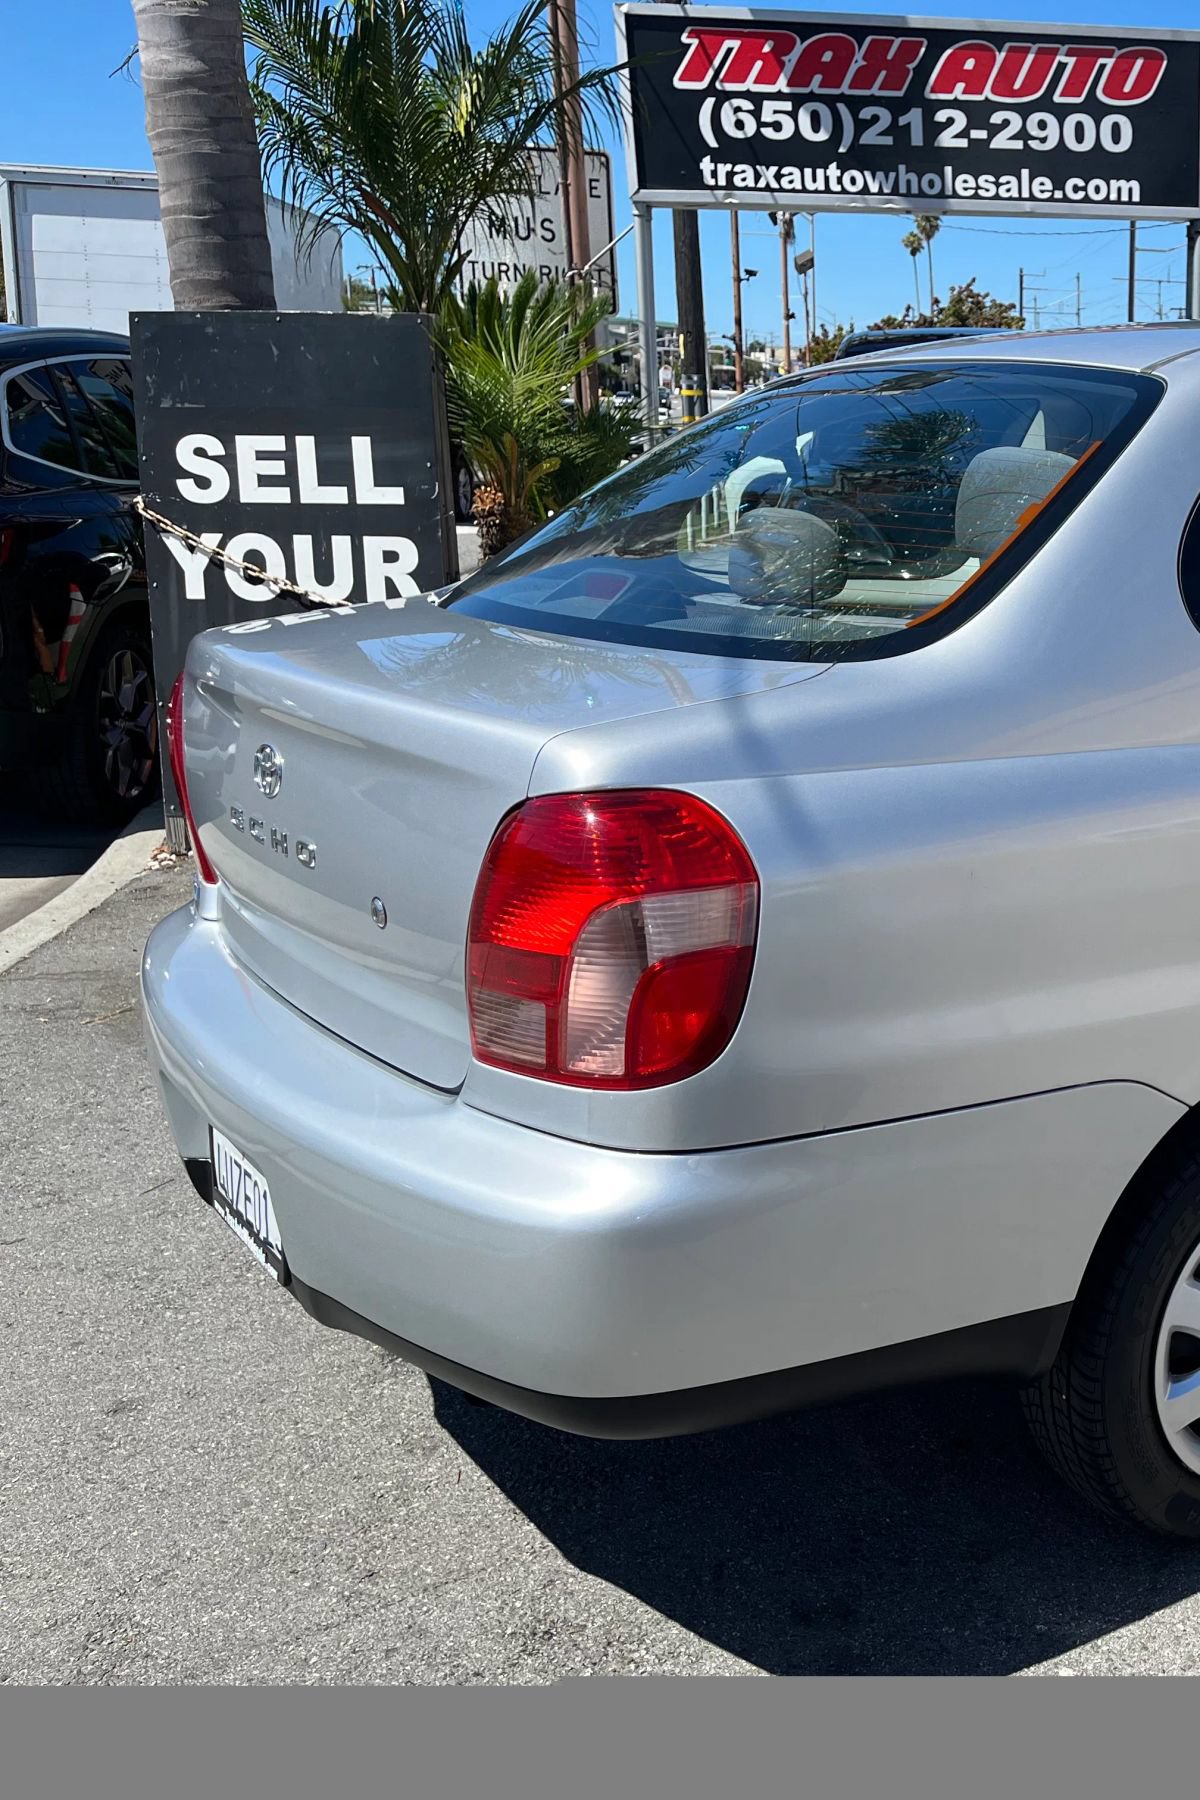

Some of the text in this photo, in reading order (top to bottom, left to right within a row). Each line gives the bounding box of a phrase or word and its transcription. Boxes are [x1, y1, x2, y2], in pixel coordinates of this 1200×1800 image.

[673, 25, 1168, 105] TRAX AUTO
[699, 97, 1133, 153] (650)212-2900
[700, 154, 1141, 202] traxautowholesale.com
[468, 260, 526, 282] TURN
[175, 433, 405, 505] SELL
[161, 532, 422, 603] YOUR
[230, 806, 316, 869] ECHO
